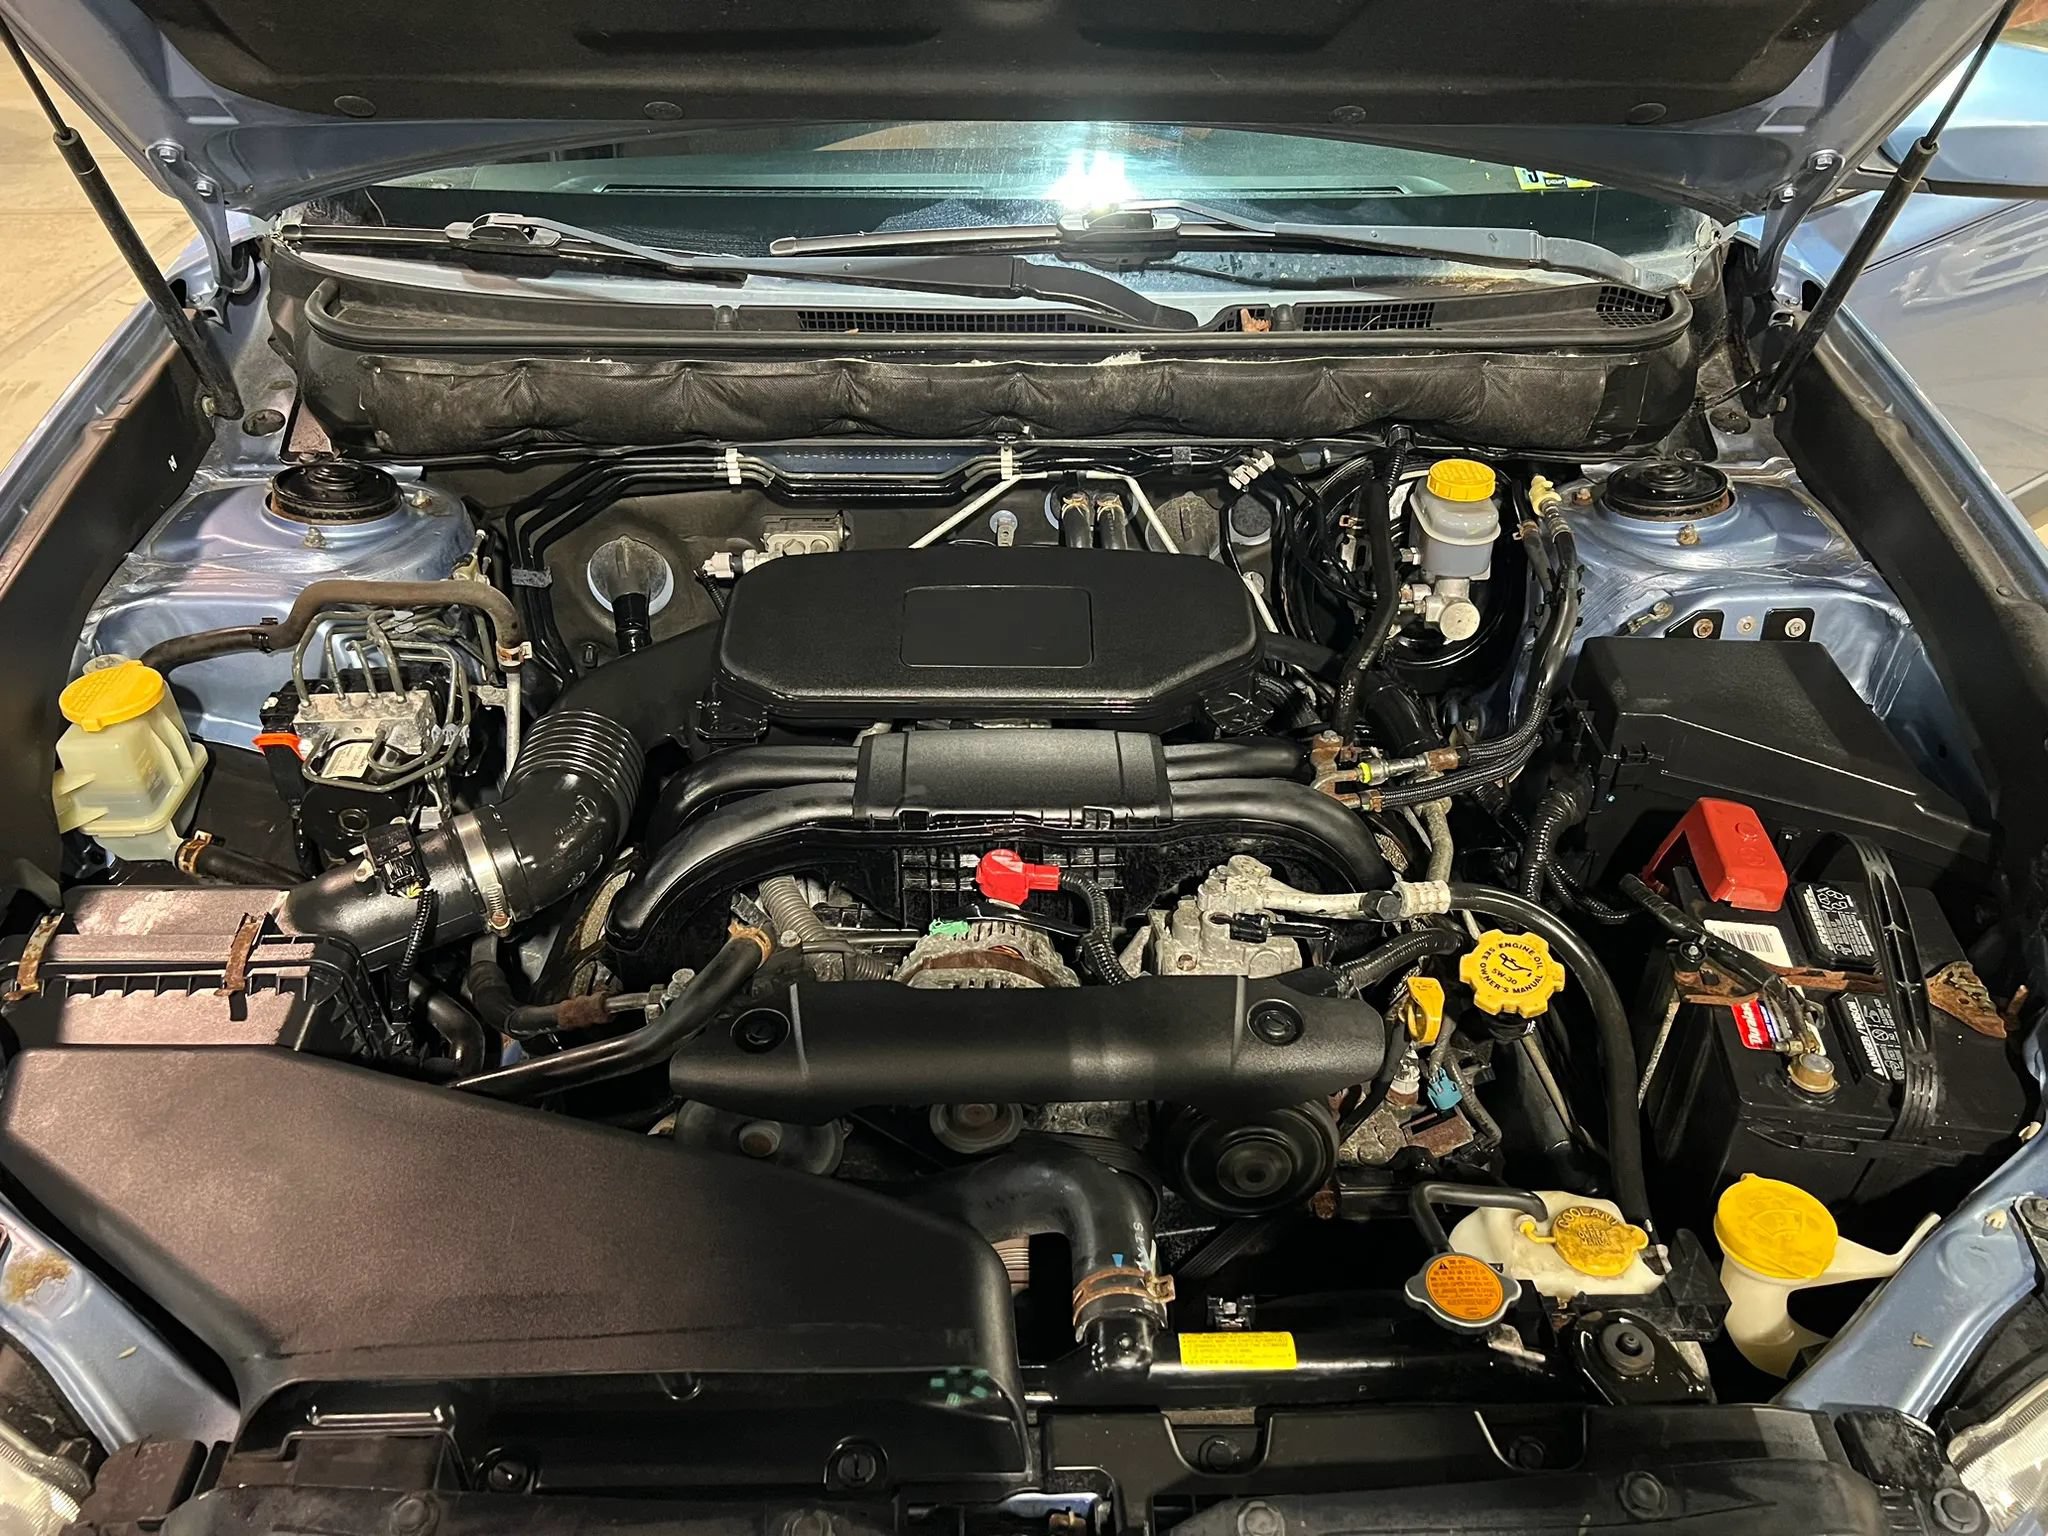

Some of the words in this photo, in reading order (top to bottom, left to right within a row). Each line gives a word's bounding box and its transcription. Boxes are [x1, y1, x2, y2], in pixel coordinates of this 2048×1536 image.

[1482, 947, 1495, 960] SEE
[1498, 943, 1535, 956] ENGINE
[1533, 956, 1543, 969] OIL
[1480, 962, 1509, 993] OWNER'S
[1491, 968, 1518, 985] 5W-30
[1513, 975, 1543, 993] MANUAL
[1558, 1207, 1619, 1229] COOLANT
